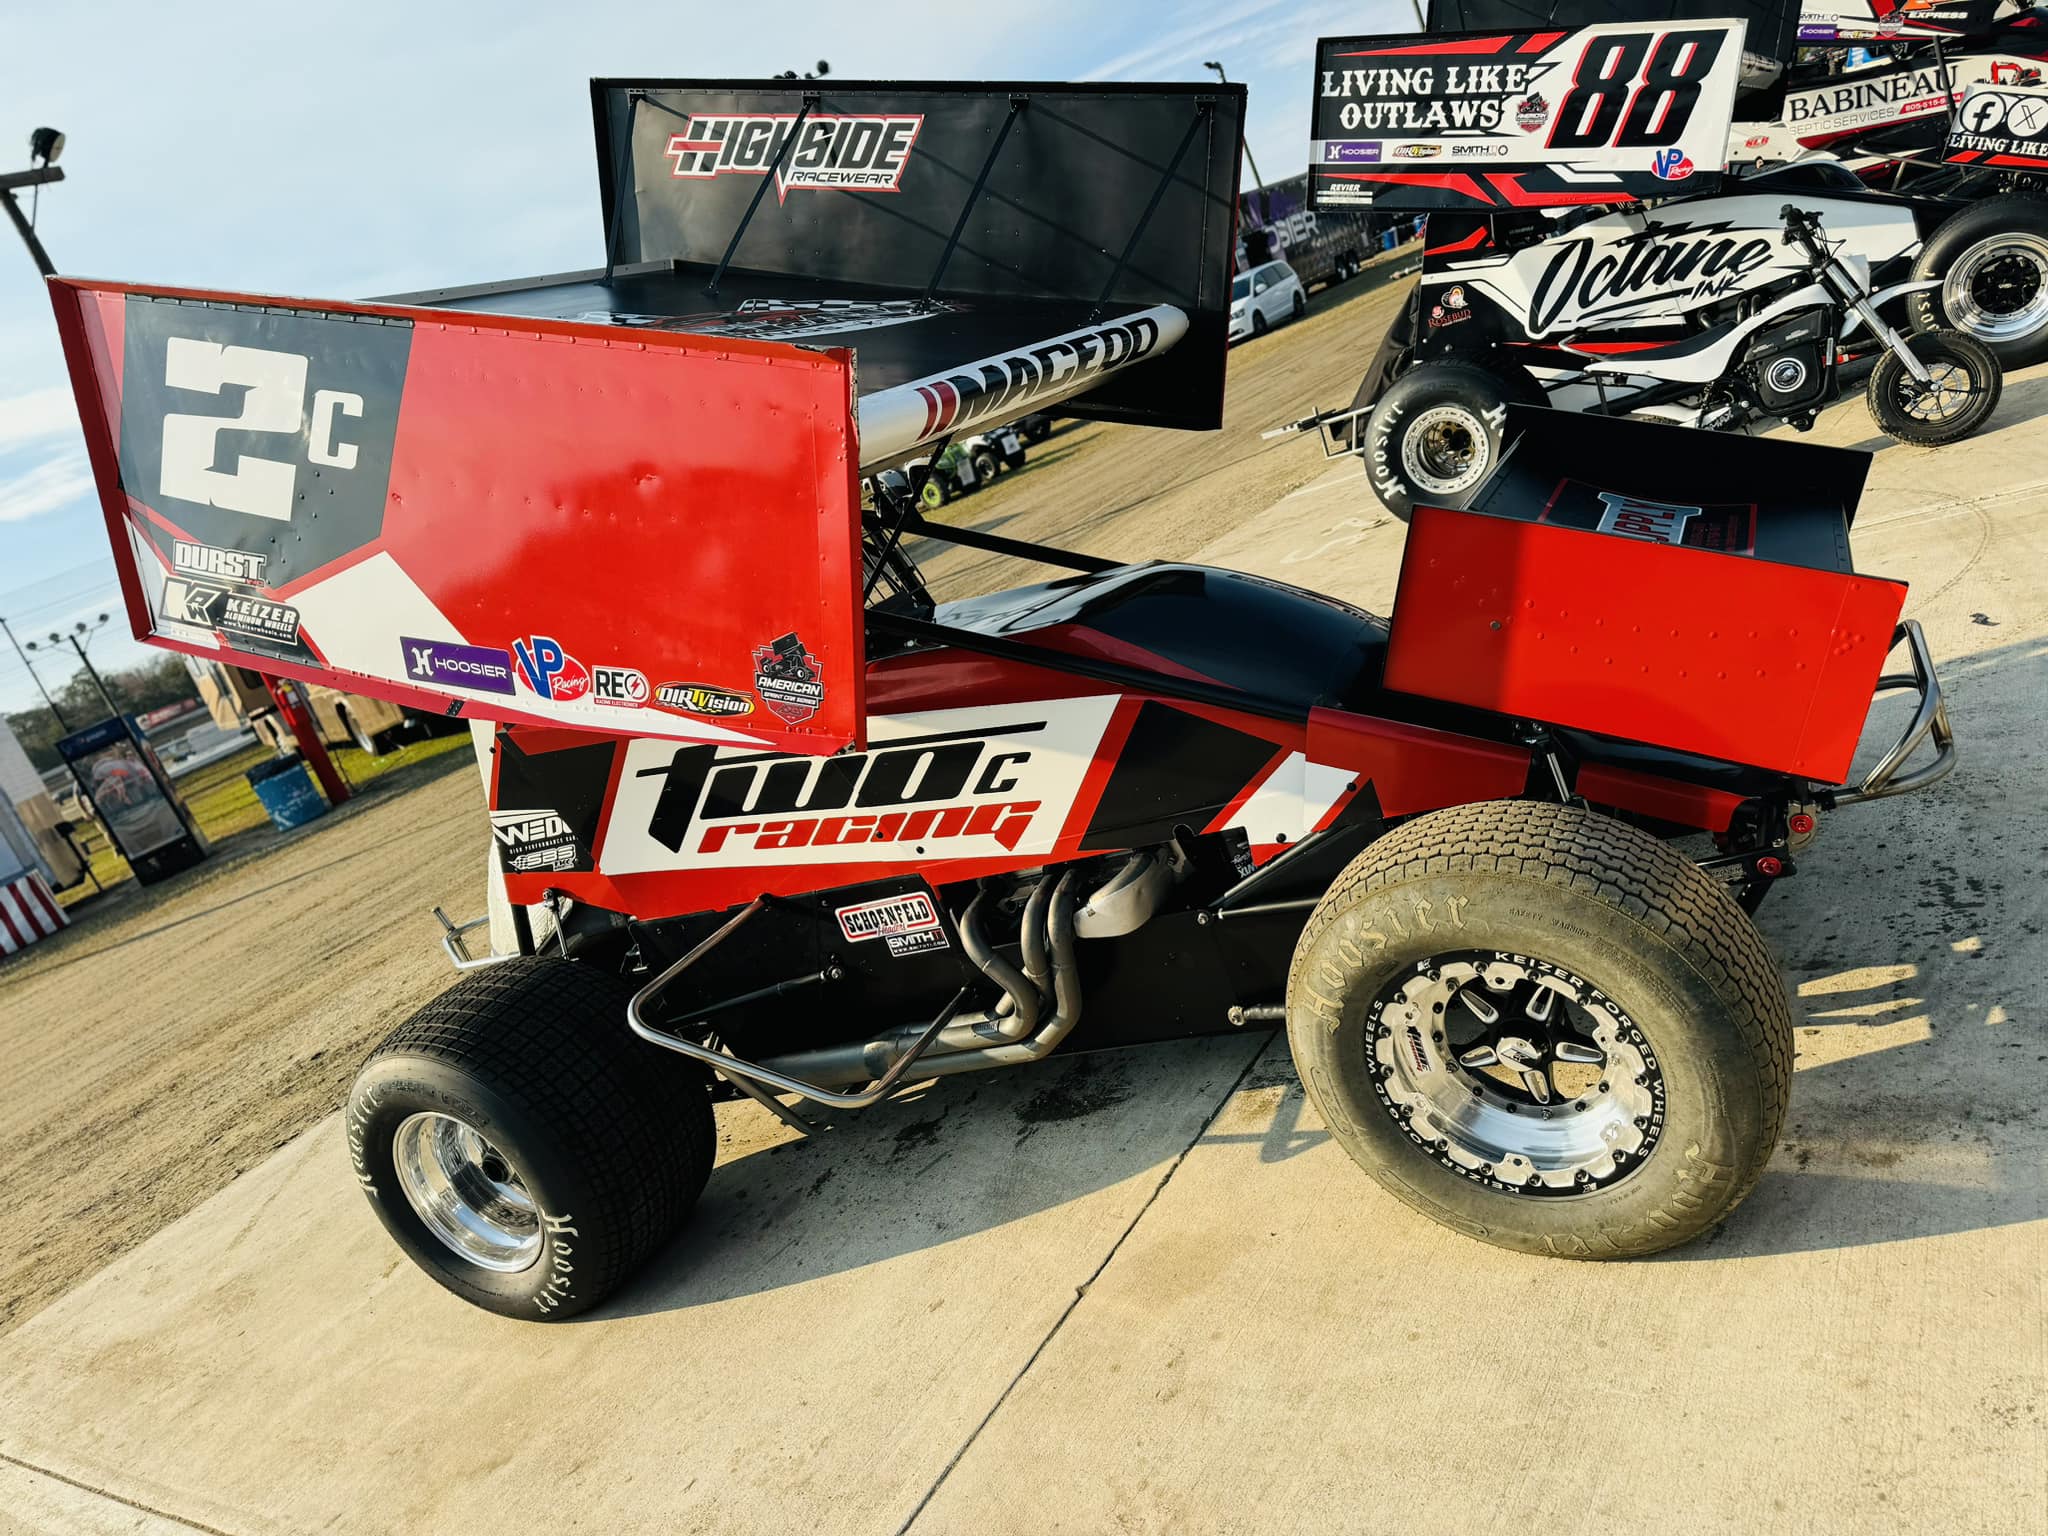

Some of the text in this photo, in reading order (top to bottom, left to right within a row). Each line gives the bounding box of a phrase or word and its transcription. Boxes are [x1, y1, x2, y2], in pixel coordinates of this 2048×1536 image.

[1908, 11, 1968, 19] EXPRESS
[1322, 64, 1530, 97] LIVING LIKE
[1544, 28, 1729, 149] 88
[1339, 99, 1501, 129] OUTLAWS
[1790, 120, 1832, 137] SEPTIC
[1833, 108, 1895, 128] SERVICES
[670, 119, 916, 178] HIGHSIDE
[1950, 134, 2048, 157] LIVING LIKE
[791, 171, 894, 185] RACEWEAR
[1656, 148, 1684, 180] VP
[1528, 233, 1774, 333] Octane
[1691, 274, 1749, 301] INK
[1427, 309, 1473, 328] ROSEBUD
[175, 541, 265, 580] DURST
[225, 598, 297, 625] KEIZER
[264, 618, 294, 633] WHEELS
[434, 656, 508, 679] HOOSIER
[513, 634, 564, 700] VP
[552, 675, 588, 695] Racing
[758, 676, 821, 697] AMERICAN
[697, 800, 1042, 853] racing
[844, 900, 930, 933] SCHOENFELD
[1302, 895, 1470, 1035] Hoosier
[1364, 999, 1384, 1075] WHEELS
[1494, 951, 1585, 988] KEIZER
[1590, 989, 1657, 1071] FORGED
[1638, 1079, 1665, 1158] WHEELS
[1375, 1082, 1435, 1155] FORGED
[1440, 1157, 1521, 1194] KEIZER
